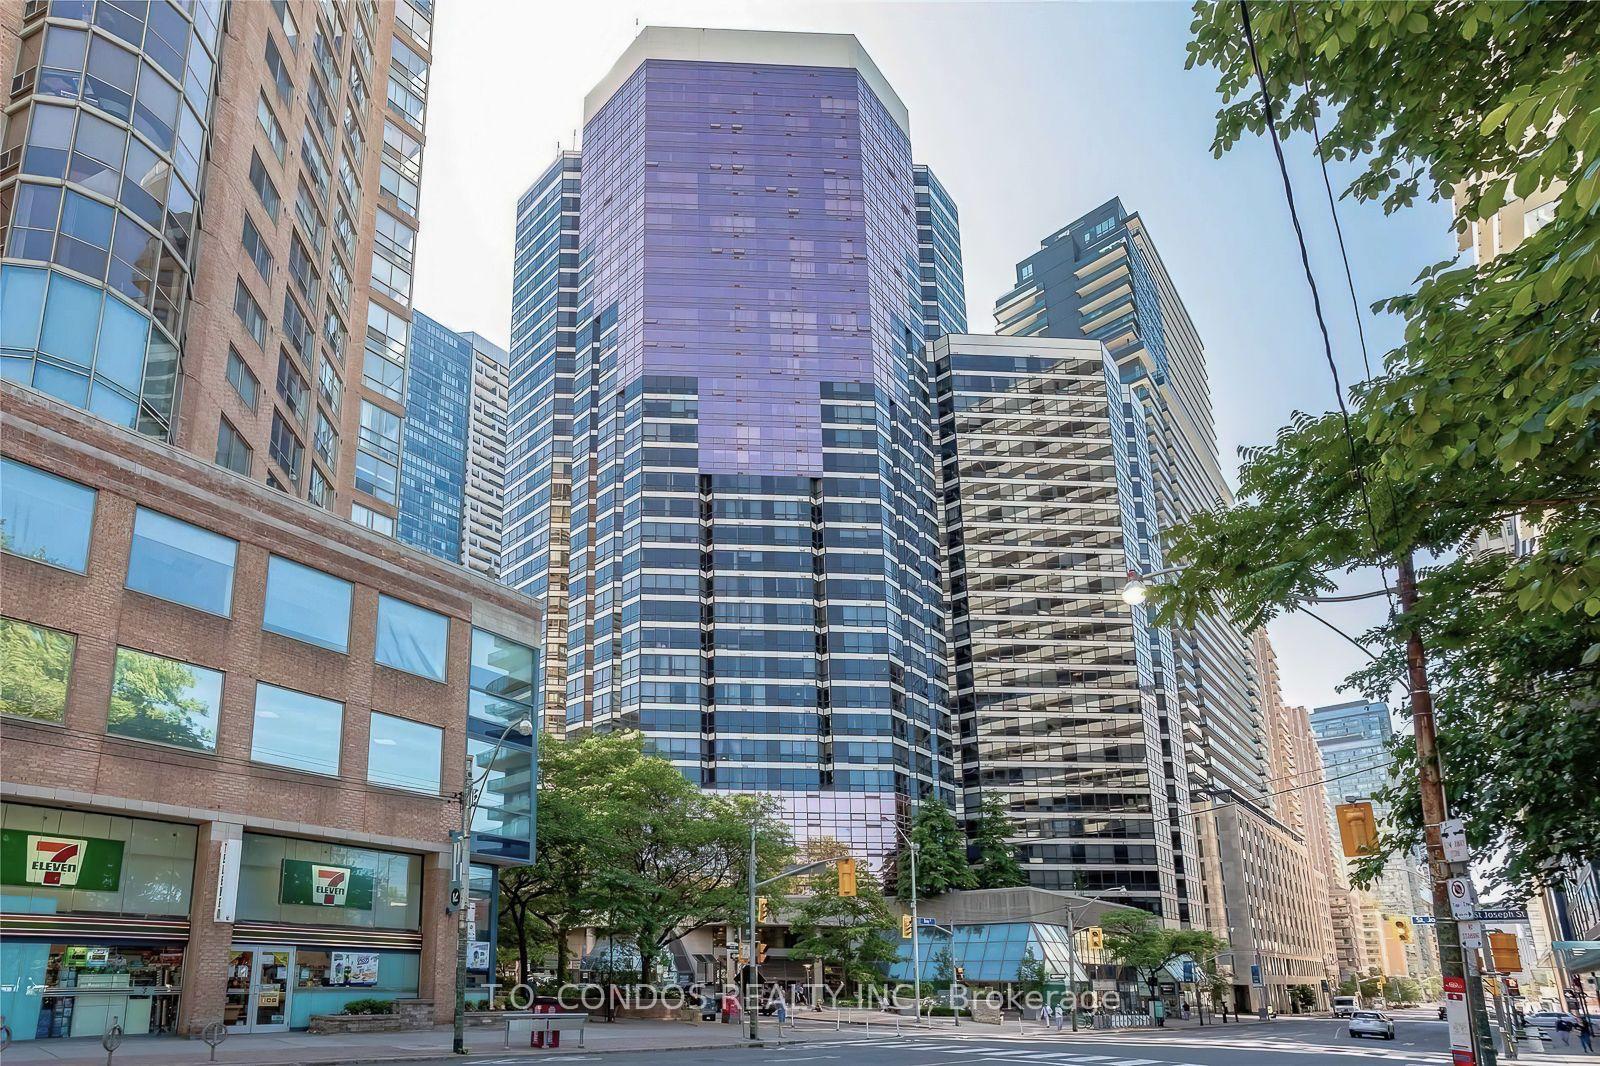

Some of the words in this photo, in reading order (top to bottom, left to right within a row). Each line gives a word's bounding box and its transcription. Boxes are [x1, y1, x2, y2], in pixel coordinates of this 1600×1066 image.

[36, 841, 79, 885] 7
[318, 869, 345, 905] 7
[1484, 911, 1515, 919] Joseph
